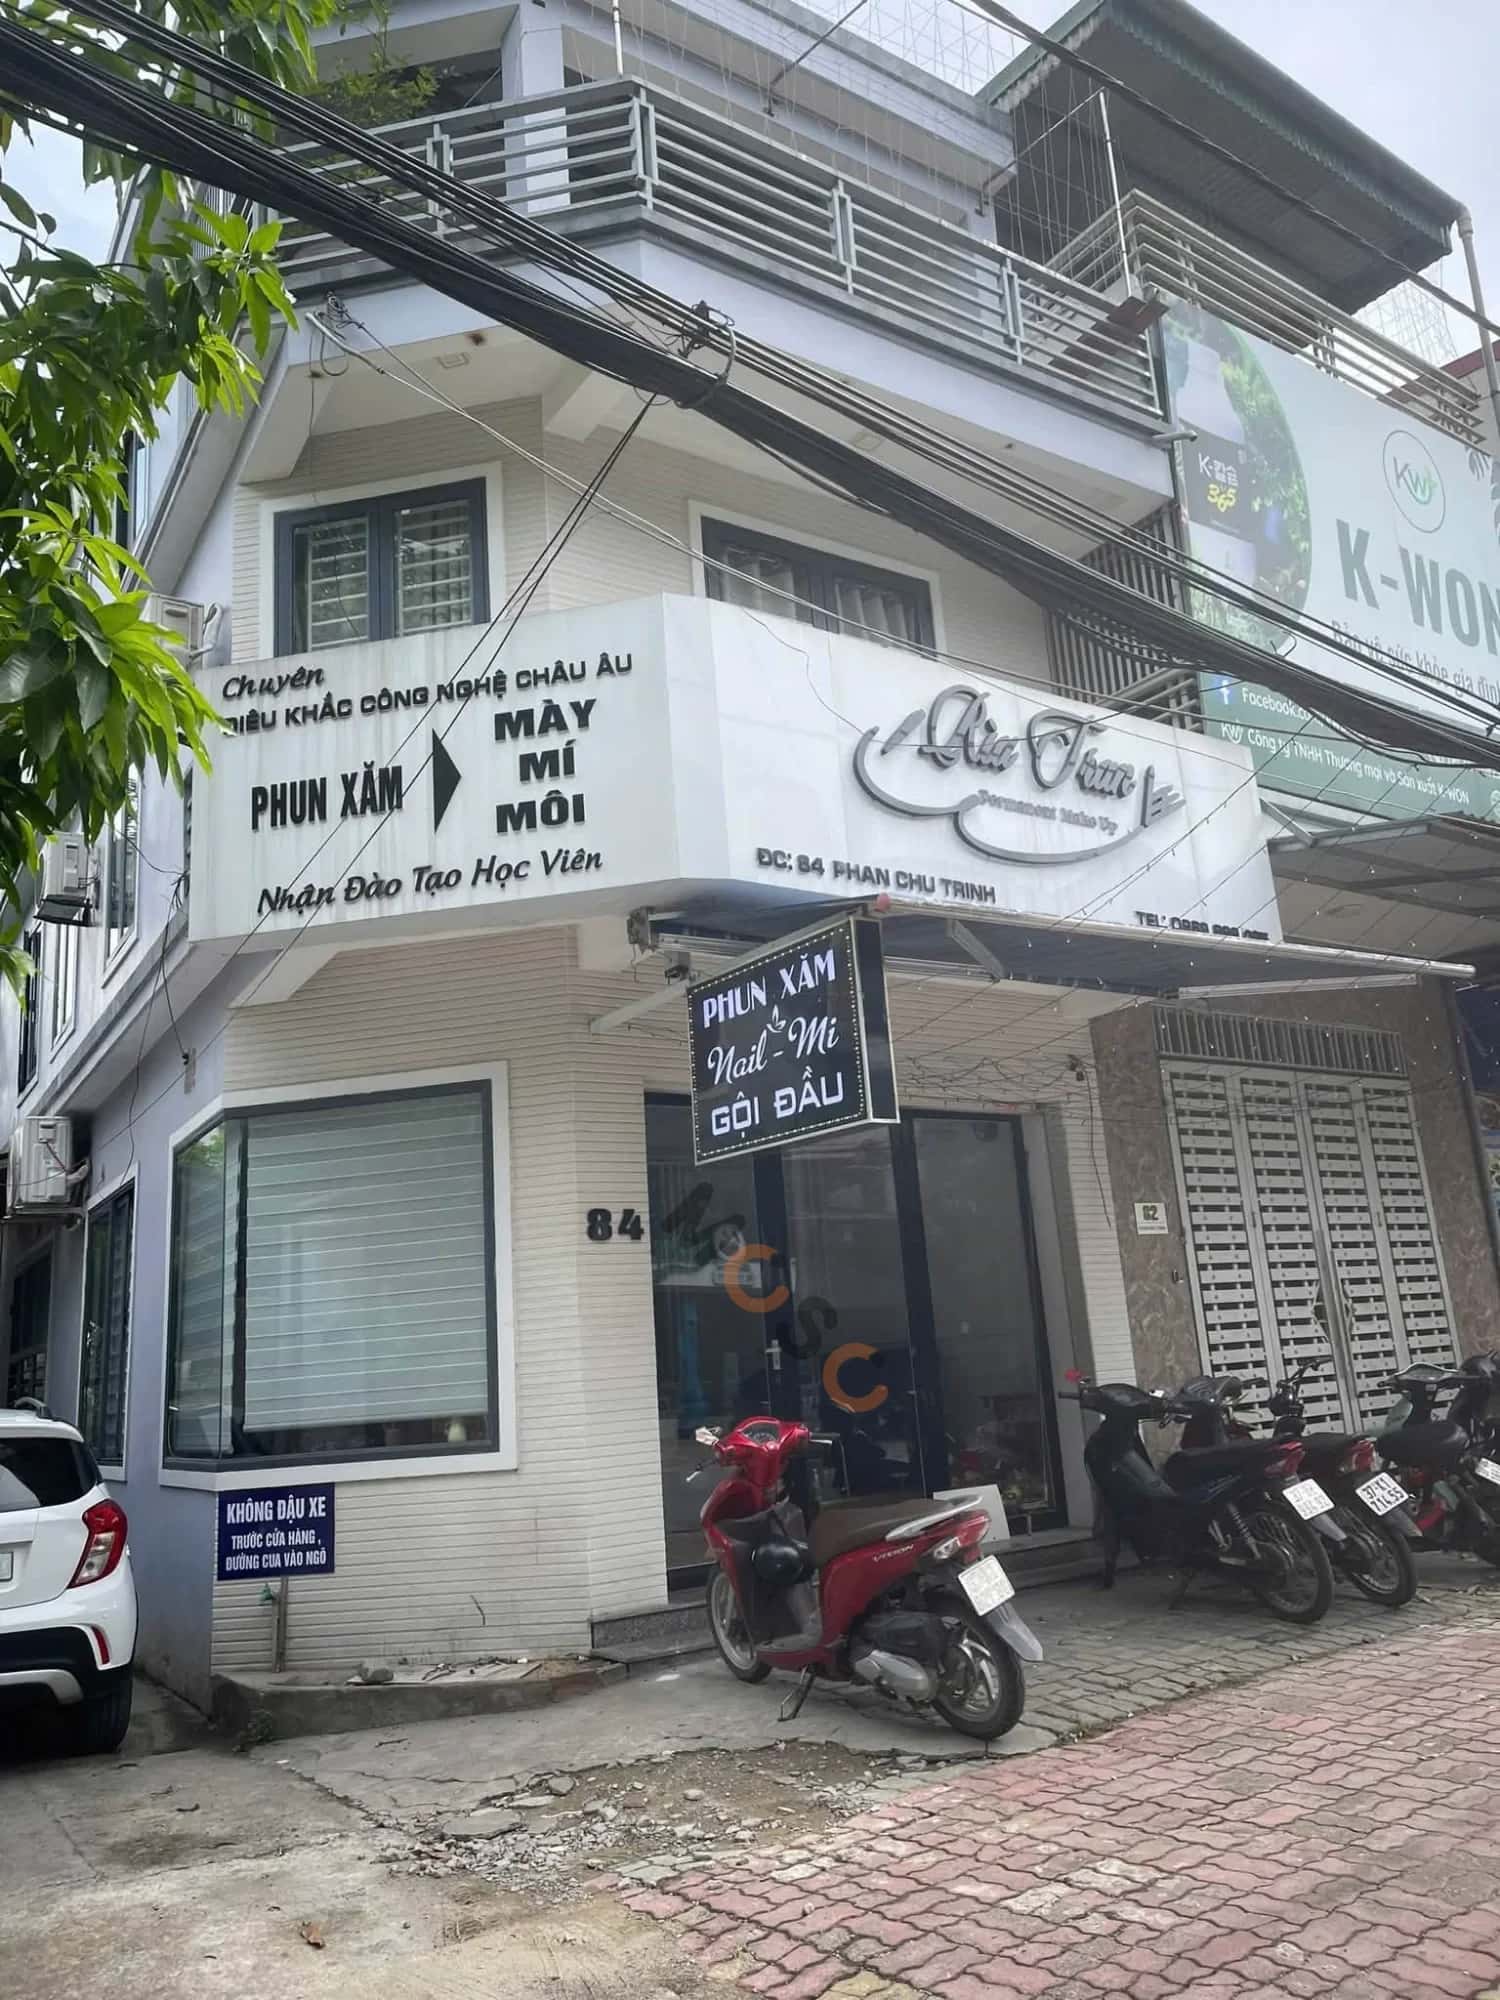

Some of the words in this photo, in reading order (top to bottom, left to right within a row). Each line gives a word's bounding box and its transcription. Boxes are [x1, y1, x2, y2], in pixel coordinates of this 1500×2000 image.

[222, 666, 325, 699] Chuyên
[285, 691, 353, 728] KHẮC
[360, 686, 430, 714] CÔNG
[436, 668, 507, 703] NGHỆ
[515, 659, 586, 690] CHÂU
[596, 652, 633, 678] ÂU
[494, 698, 598, 742] MÀY
[518, 739, 577, 784] MÍ
[1248, 728, 1277, 754] Công
[1279, 739, 1291, 758] ty
[1291, 739, 1323, 764] TNHH
[250, 777, 328, 832] PHUN
[340, 760, 404, 819] XĂM
[495, 789, 587, 835] MÔI
[256, 883, 336, 914] Nhận
[344, 871, 403, 903] Đào
[413, 864, 463, 897] Tạo
[471, 855, 531, 888] Học
[540, 848, 604, 878] Viên
[797, 854, 825, 877] 84
[832, 860, 891, 888] PHAN
[895, 870, 935, 894] CHU
[939, 878, 996, 904] TRINH
[703, 975, 767, 1028] PHUN
[779, 949, 836, 999] XĂM
[707, 1029, 768, 1085] Nail
[787, 1016, 840, 1059] Mi
[711, 1091, 761, 1138] GỘI
[773, 1066, 844, 1119] ĐẦU
[586, 1207, 645, 1242] 84
[227, 1498, 273, 1524] KHÔNG
[308, 1496, 326, 1518] XE
[231, 1530, 263, 1550] TRƯỚC
[284, 1549, 304, 1567] VÀO
[306, 1547, 327, 1565] NGÕ
